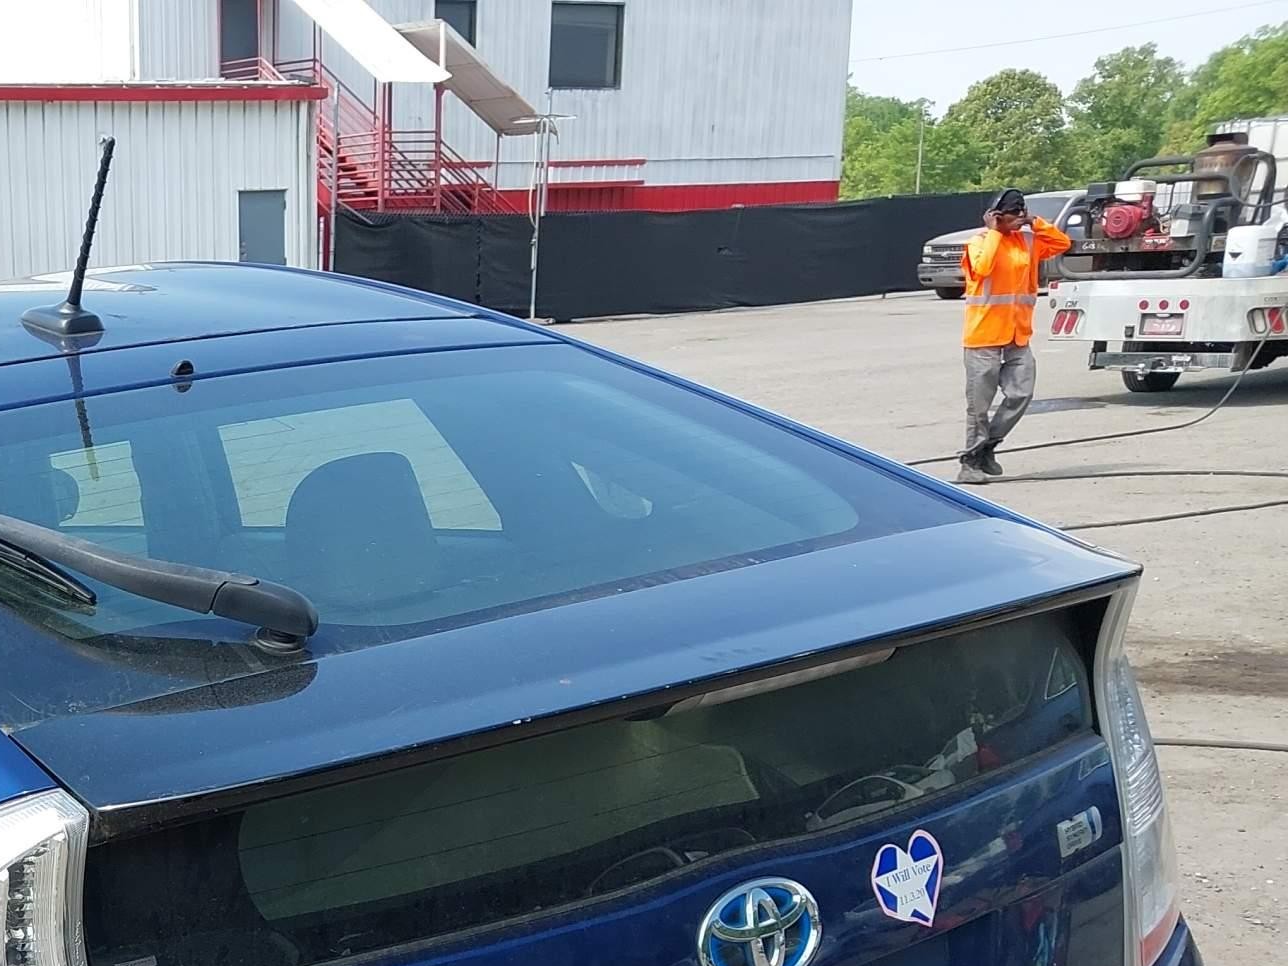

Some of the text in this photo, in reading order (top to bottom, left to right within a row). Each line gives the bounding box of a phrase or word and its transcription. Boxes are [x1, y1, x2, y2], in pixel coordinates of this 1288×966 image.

[885, 863, 931, 888] I Will Vote
[899, 887, 925, 906] 11.3.20
